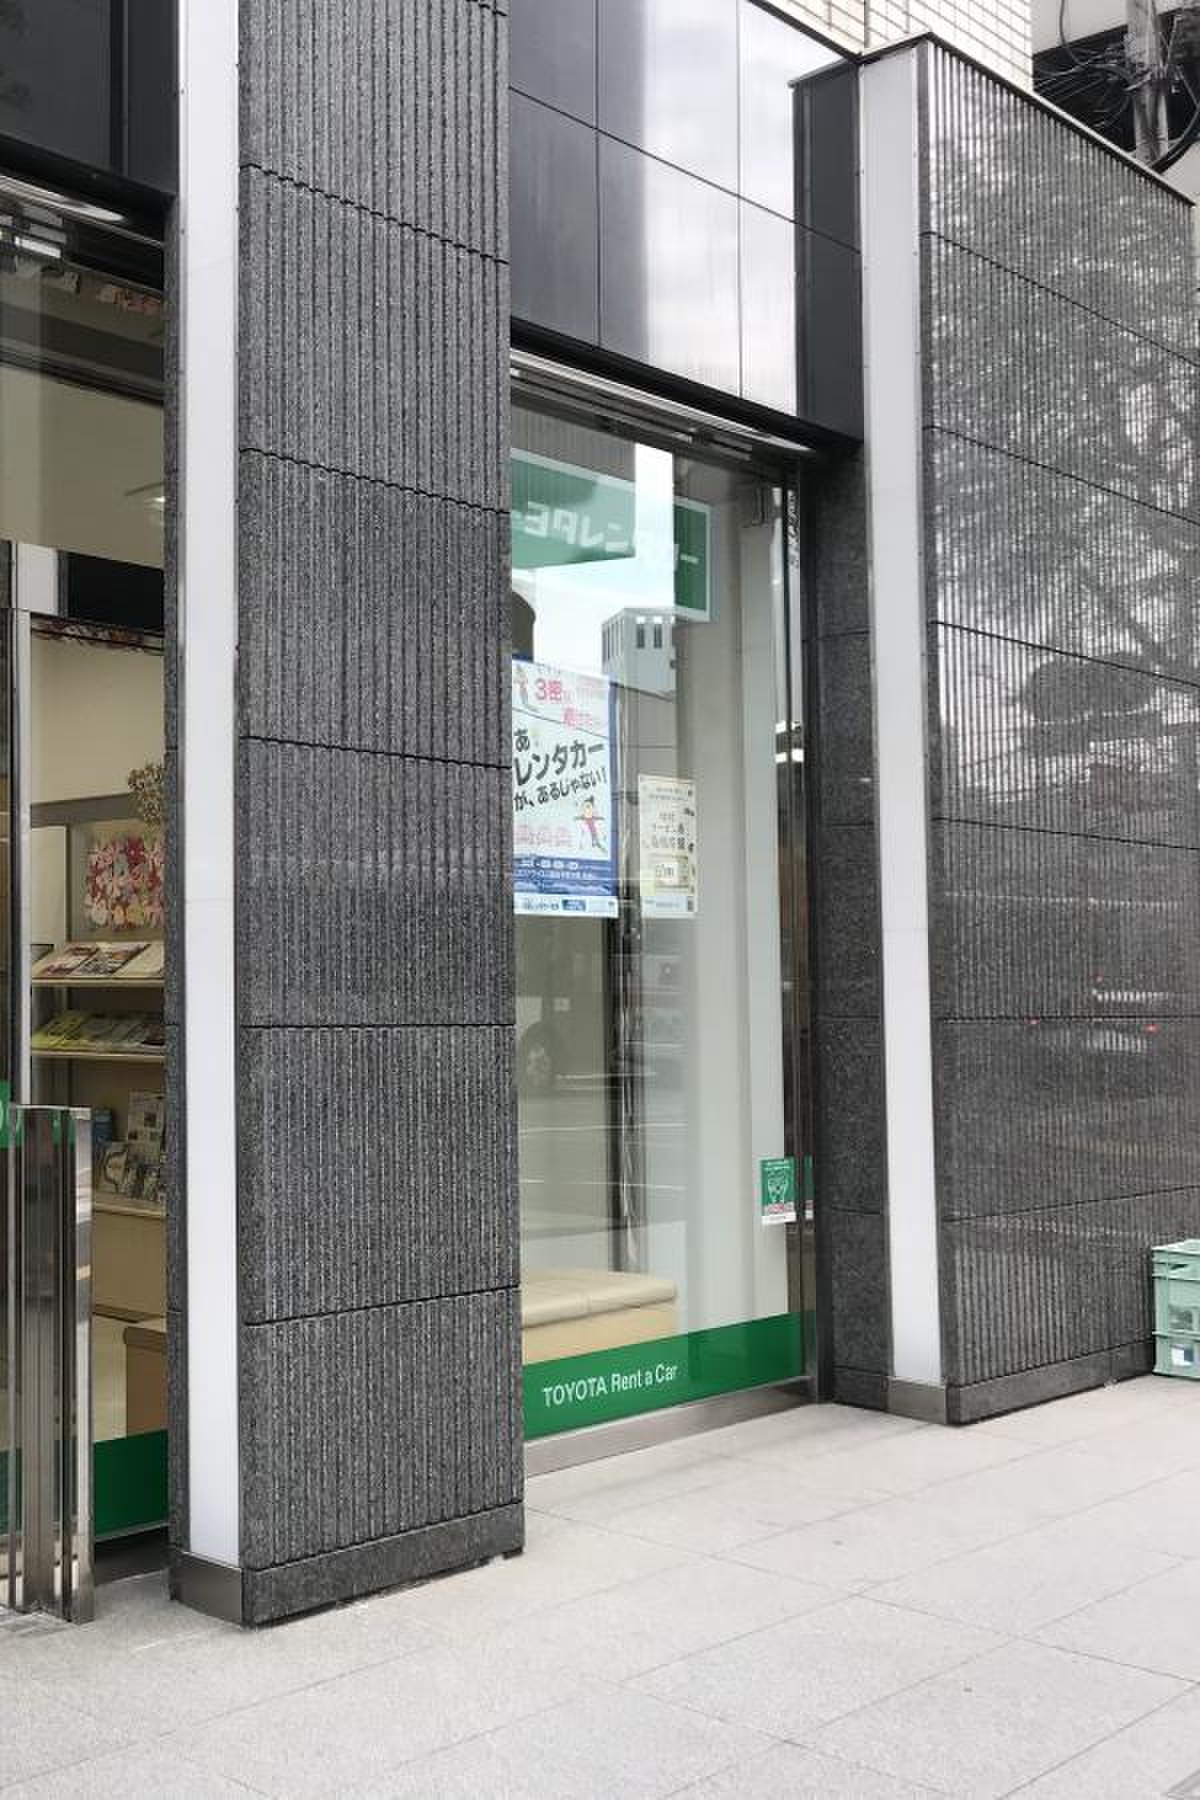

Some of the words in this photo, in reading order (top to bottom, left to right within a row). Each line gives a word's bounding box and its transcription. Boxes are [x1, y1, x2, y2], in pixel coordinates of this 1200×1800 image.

[513, 739, 604, 787] レンタカー
[542, 1375, 609, 1408] TOYOTA
[611, 1369, 642, 1393] Rent
[644, 1371, 653, 1385] a
[655, 1363, 678, 1383] Car
